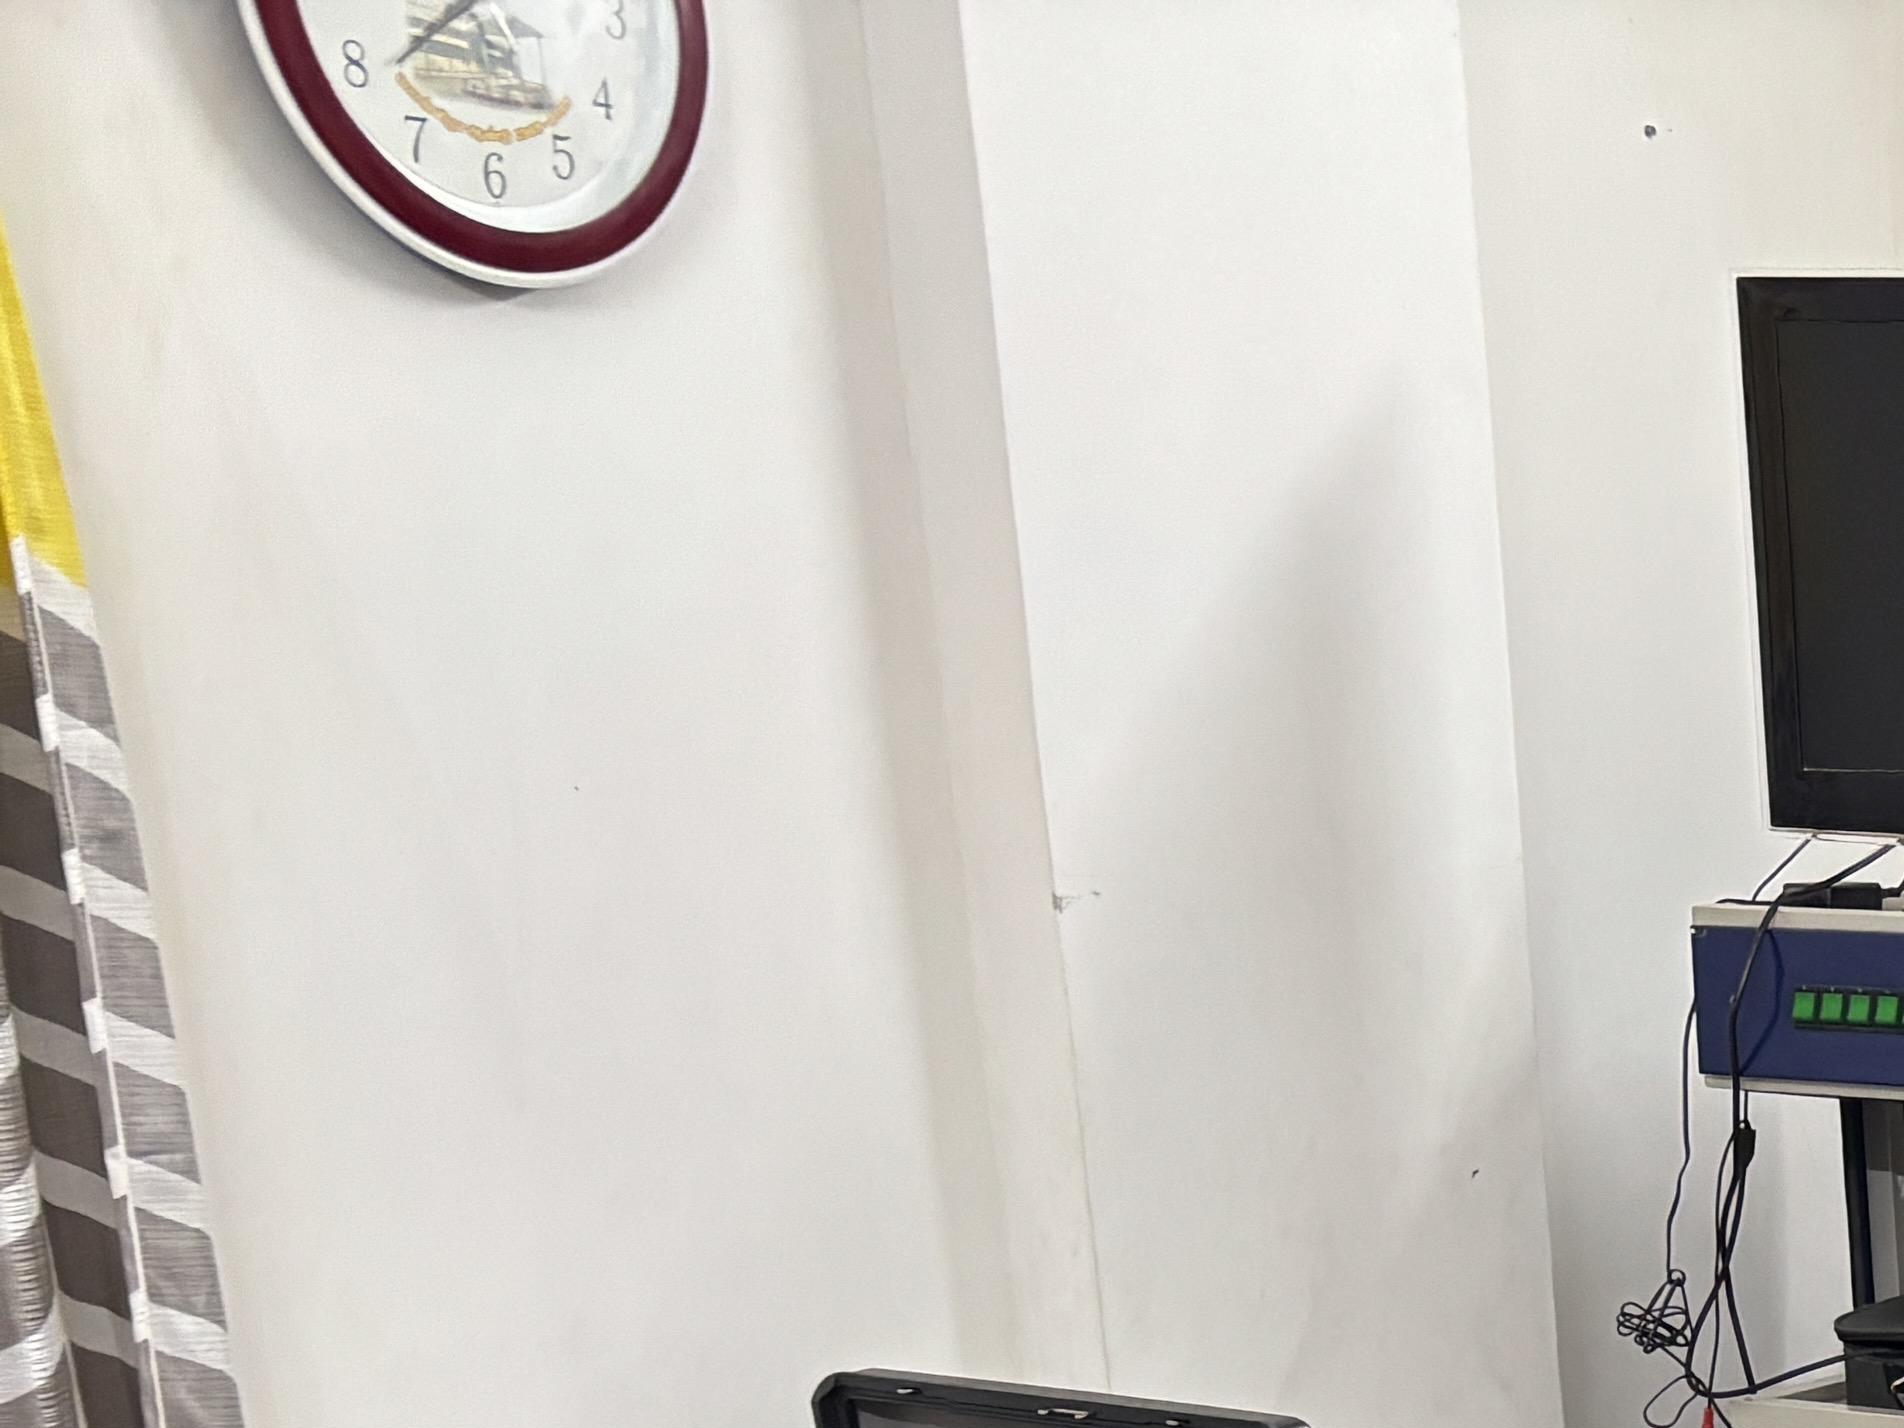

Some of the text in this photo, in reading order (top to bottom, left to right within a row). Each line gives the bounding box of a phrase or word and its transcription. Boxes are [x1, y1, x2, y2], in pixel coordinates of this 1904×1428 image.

[341, 38, 369, 89] 8
[591, 78, 615, 122] 4
[403, 115, 430, 164] 7
[551, 134, 577, 182] 5
[483, 152, 508, 200] 6
